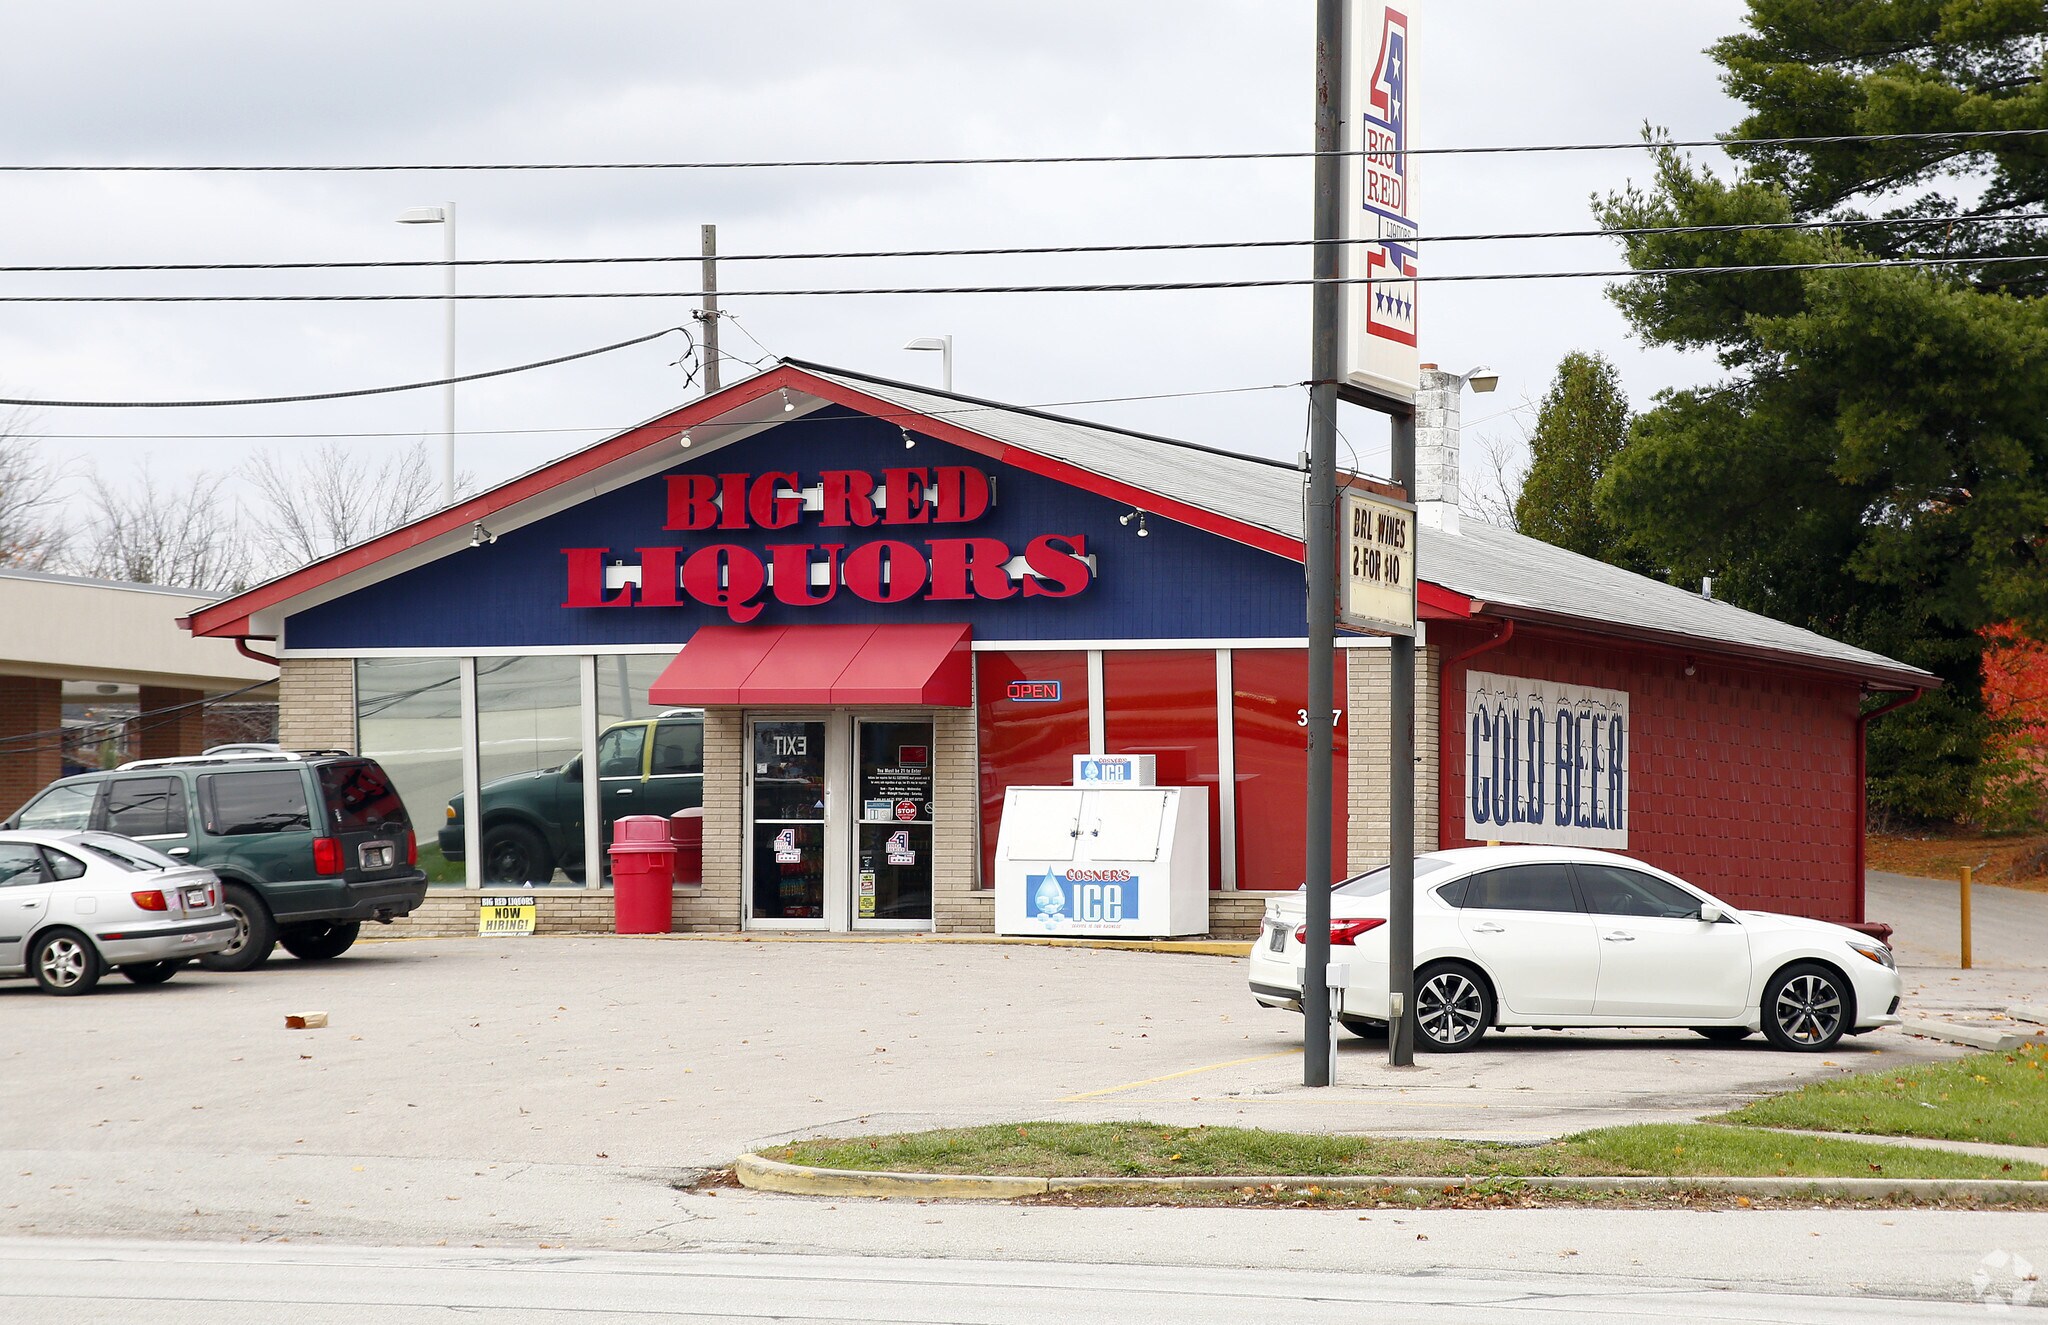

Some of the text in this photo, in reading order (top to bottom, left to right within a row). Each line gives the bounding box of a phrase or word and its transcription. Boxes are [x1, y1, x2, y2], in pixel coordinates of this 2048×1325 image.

[1367, 129, 1395, 170] BIG
[1367, 169, 1401, 209] RED
[662, 465, 991, 530] BIG RED
[1353, 508, 1406, 549] BRL WINES
[560, 533, 1092, 623] LIQUORS
[1363, 547, 1381, 581] FOR
[1384, 553, 1400, 584] $10
[1007, 684, 1057, 698] OPEN
[1472, 688, 1624, 830] COLD BEER
[1066, 869, 1130, 881] COSNER'S
[482, 897, 533, 906] BIG RED LIQUORS
[494, 907, 521, 918] NOW
[485, 919, 529, 930] HIRING!
